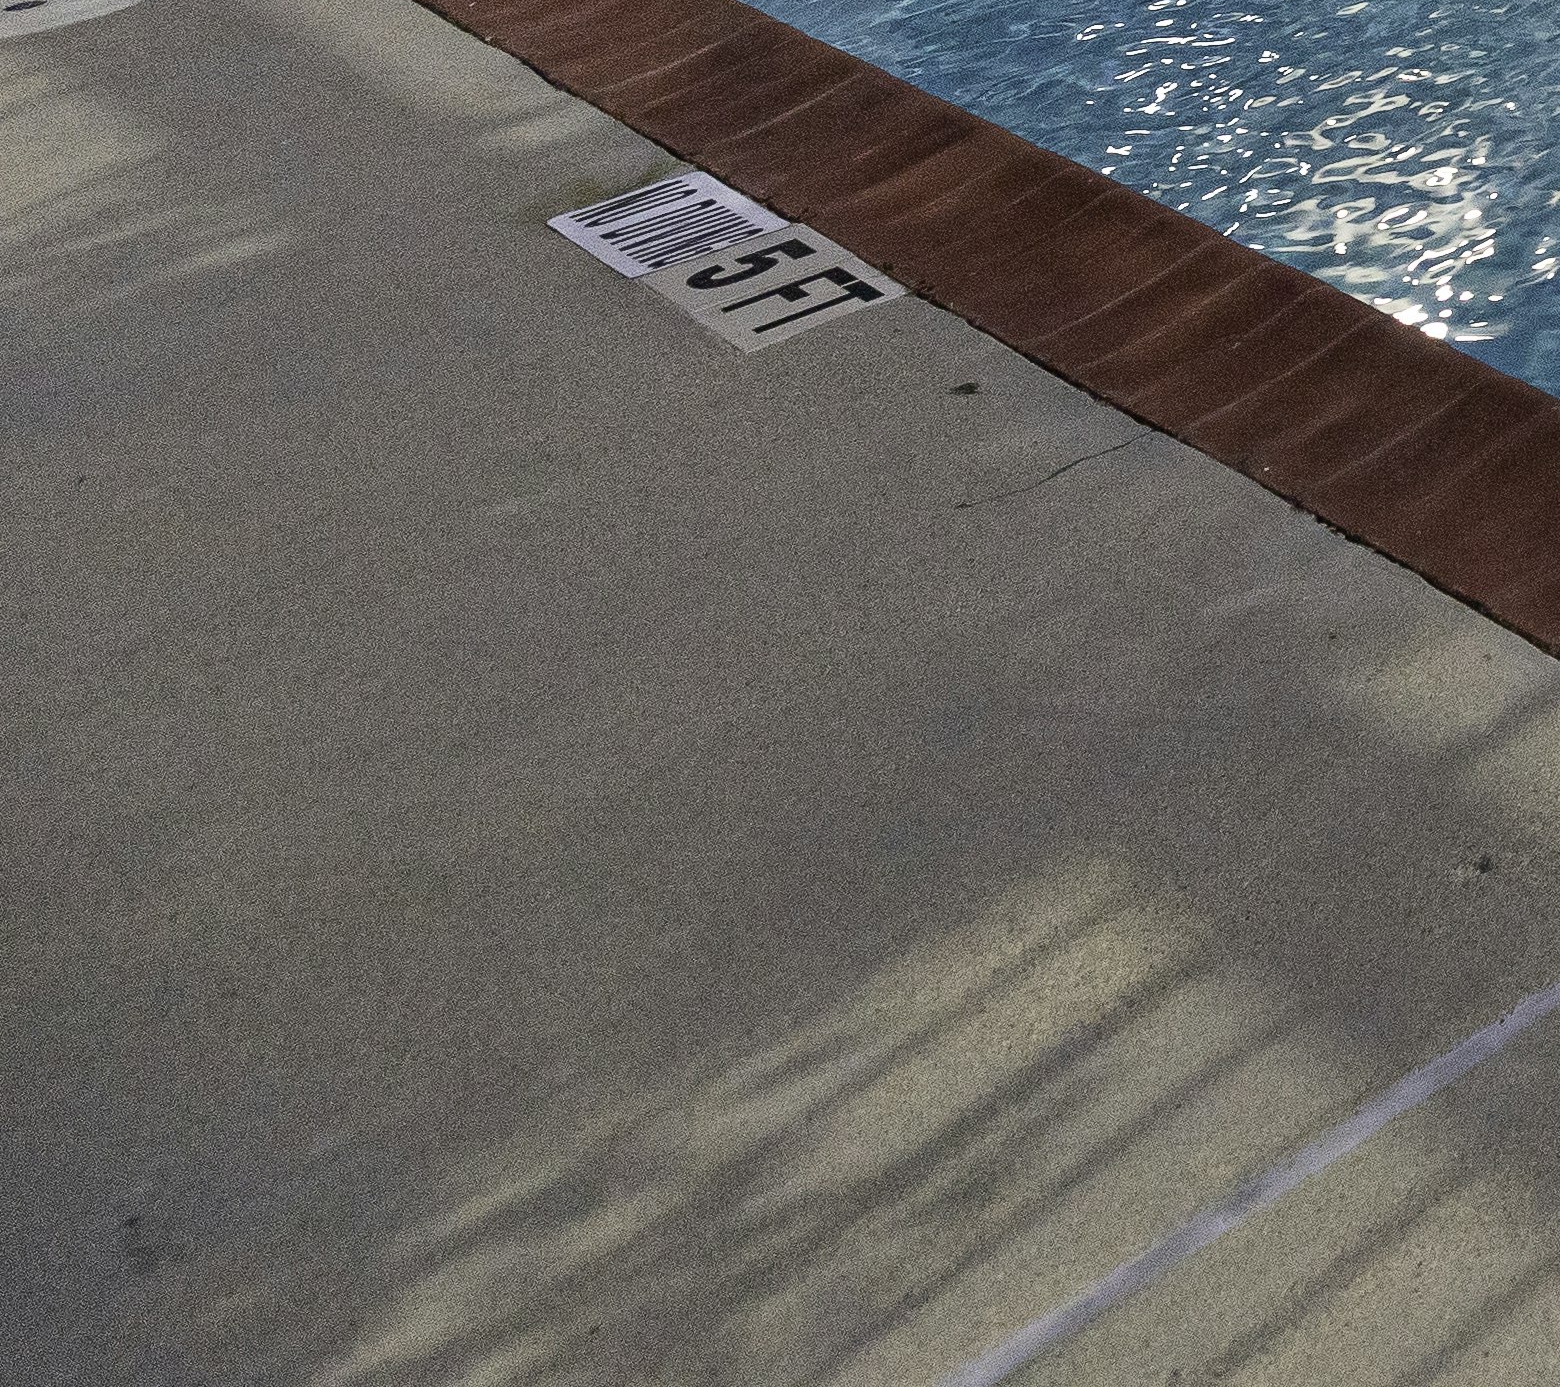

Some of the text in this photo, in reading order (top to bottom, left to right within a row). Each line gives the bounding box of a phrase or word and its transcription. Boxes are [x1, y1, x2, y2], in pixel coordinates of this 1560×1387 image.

[569, 179, 765, 270] NO DIVING
[686, 238, 886, 334] 5 FT
